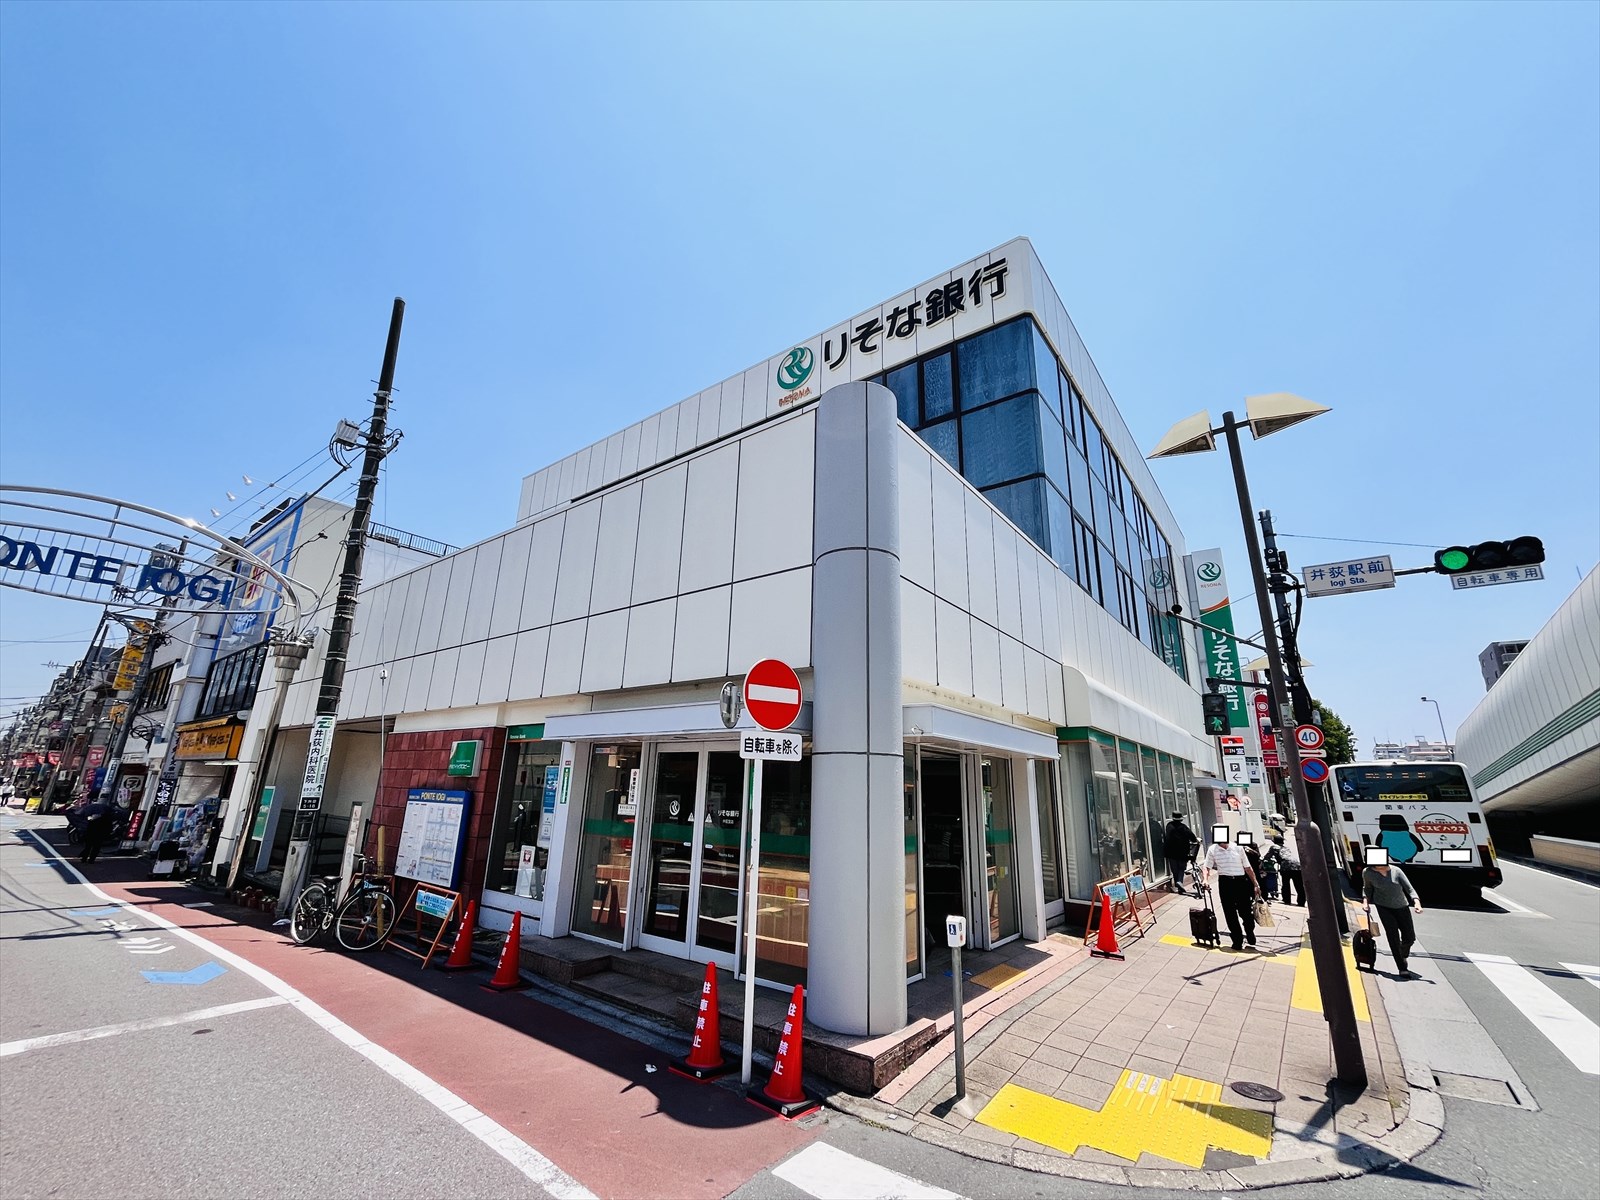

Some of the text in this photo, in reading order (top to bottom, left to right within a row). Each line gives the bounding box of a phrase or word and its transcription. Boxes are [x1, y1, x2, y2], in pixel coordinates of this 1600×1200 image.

[823, 257, 1008, 370] りそな銀行
[778, 386, 811, 407] RESONA
[1310, 559, 1385, 582] 井荻駅前
[1456, 567, 1539, 587] 自転車専用
[135, 563, 233, 606] IOGI
[1330, 576, 1368, 588] Iogi Sta.
[744, 736, 799, 755] 自転車を除く
[1301, 731, 1317, 742] 40
[304, 729, 324, 784] 井荻内科医院
[717, 809, 740, 818] りそな銀行
[693, 981, 712, 1048] 駐車禁止
[773, 1002, 797, 1076] 駐車禁止
